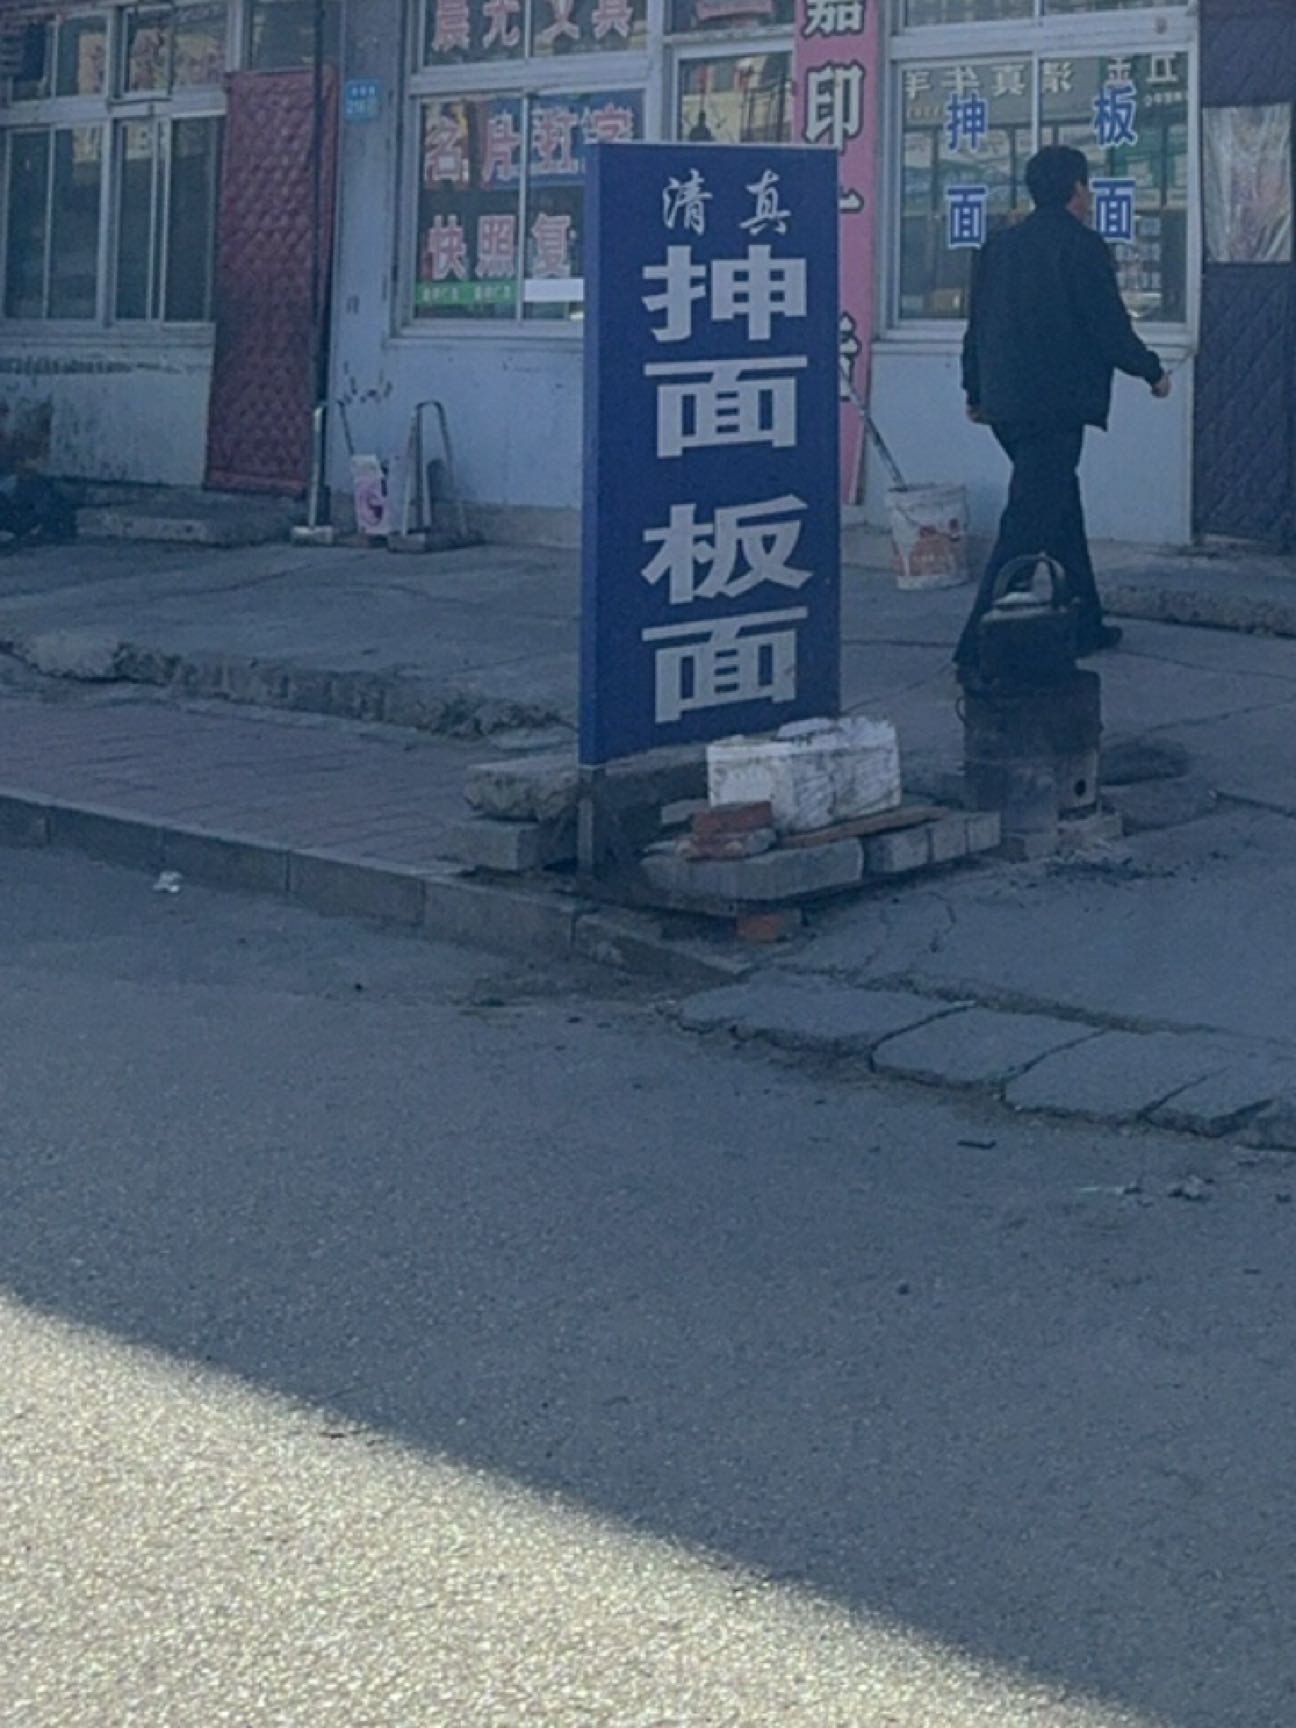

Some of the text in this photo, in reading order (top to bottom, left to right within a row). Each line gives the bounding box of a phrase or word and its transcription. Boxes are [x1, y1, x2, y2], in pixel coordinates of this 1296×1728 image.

[662, 169, 792, 236] 清真
[944, 90, 989, 250] 抻面
[1092, 84, 1139, 245] 板面
[428, 211, 583, 281] 快照复
[641, 244, 813, 723] 抻面 板面
